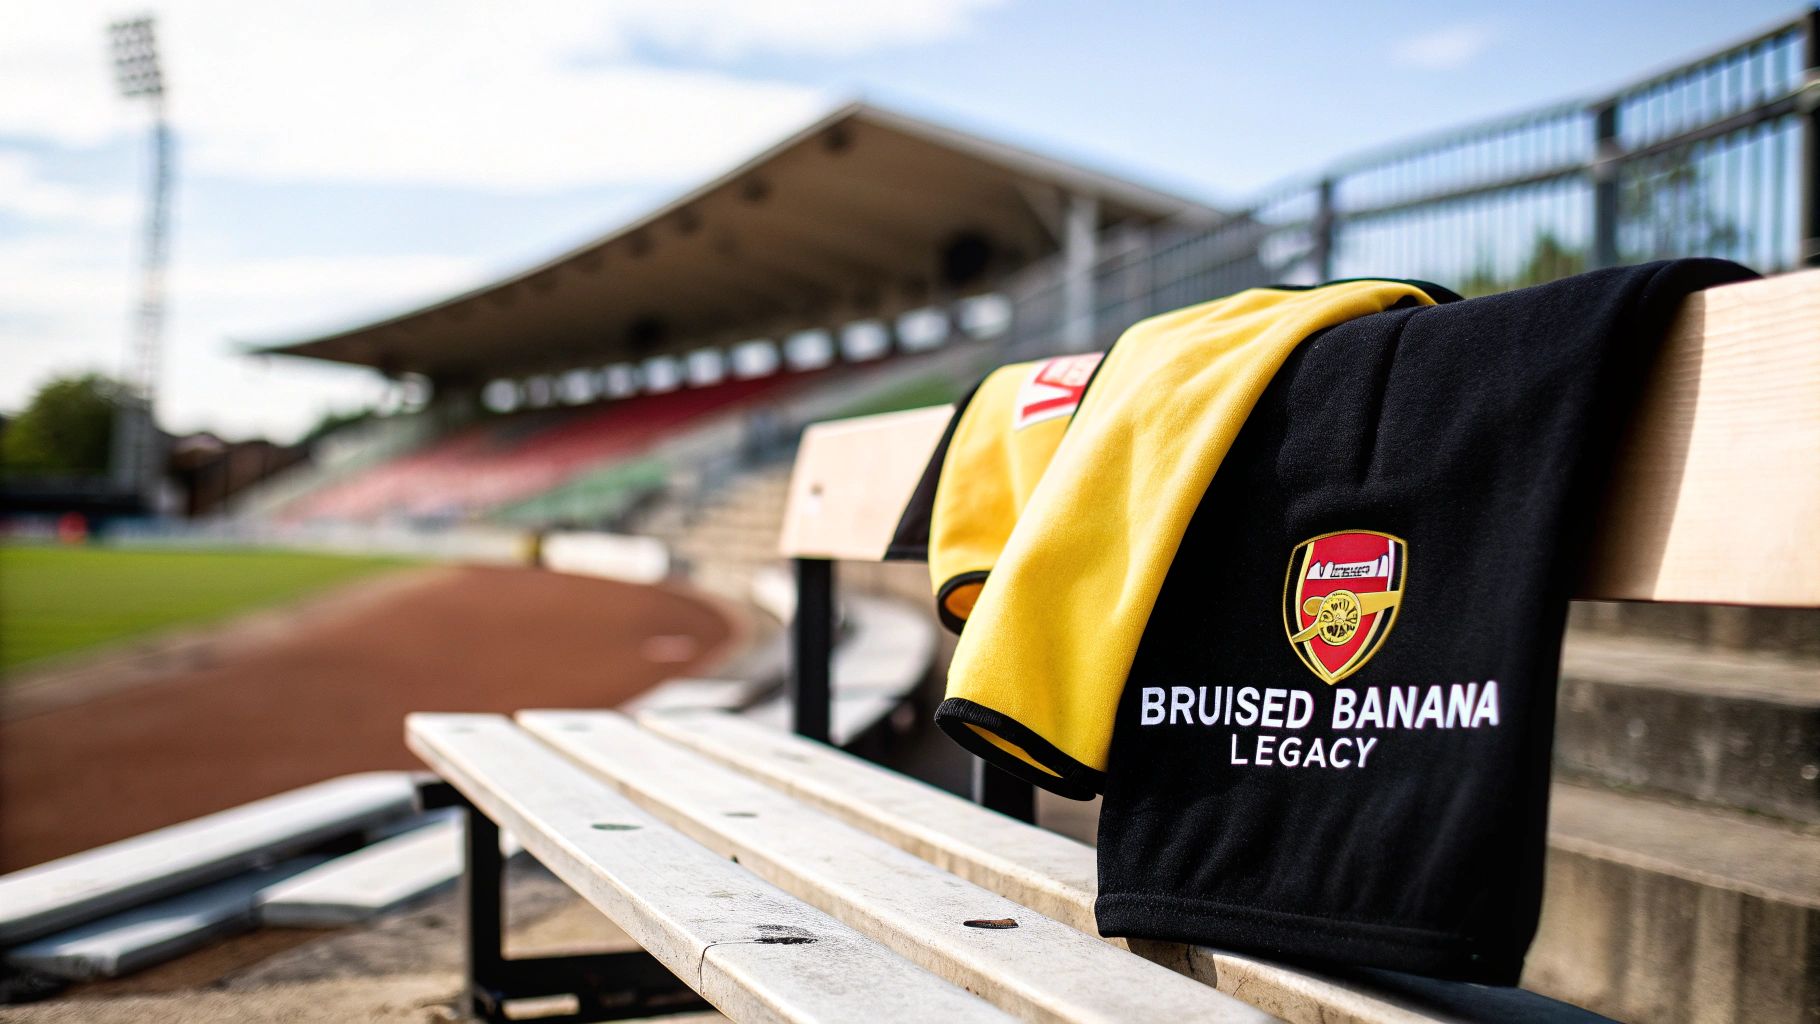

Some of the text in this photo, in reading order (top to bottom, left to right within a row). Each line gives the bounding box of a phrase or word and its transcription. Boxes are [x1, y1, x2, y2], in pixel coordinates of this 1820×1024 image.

[1140, 680, 1500, 730] BRUISED BANANA
[1230, 733, 1378, 769] LEGACY
